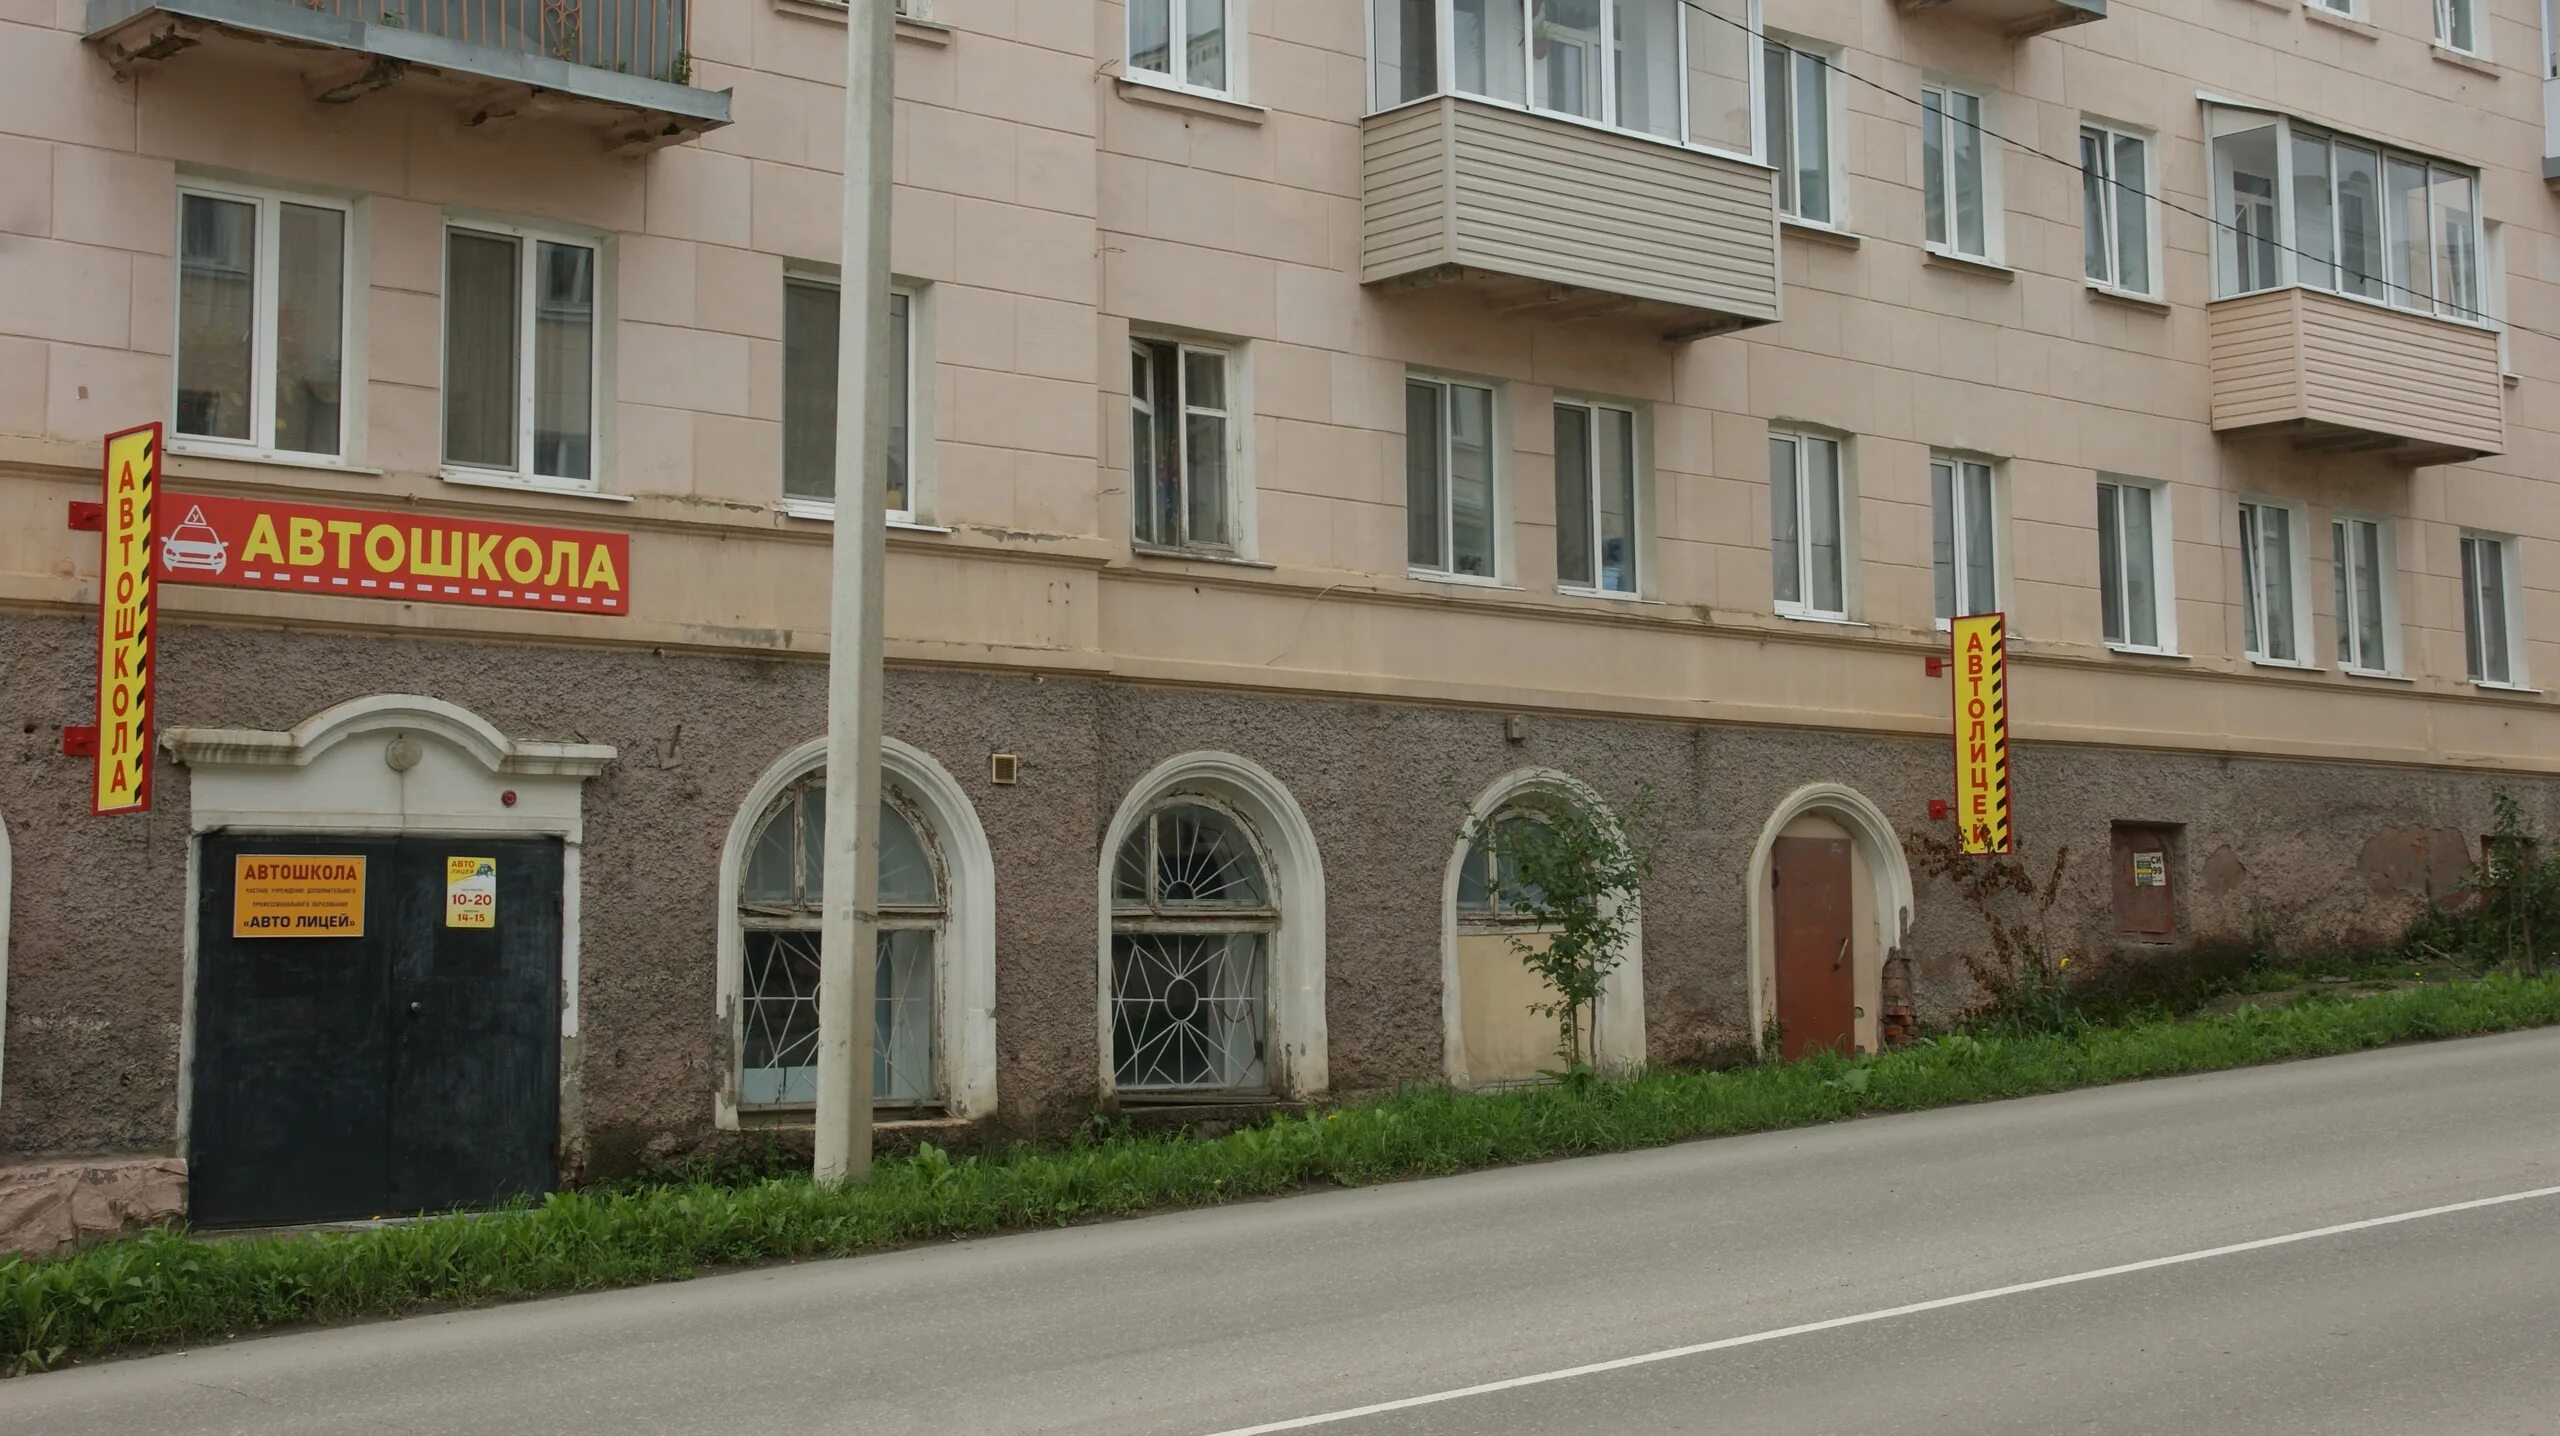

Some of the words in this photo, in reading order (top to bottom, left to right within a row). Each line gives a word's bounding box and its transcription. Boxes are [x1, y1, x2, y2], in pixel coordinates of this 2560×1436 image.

[241, 514, 620, 591] АВТОШКОЛА
[110, 460, 135, 793] АВТОШКОЛА
[1966, 632, 1988, 844] АВТОЛИЦЕЙ
[244, 864, 357, 880] АВТОШКОЛА
[451, 860, 475, 868] АВТО
[452, 894, 492, 906] 10-20
[458, 913, 485, 922] 14-15
